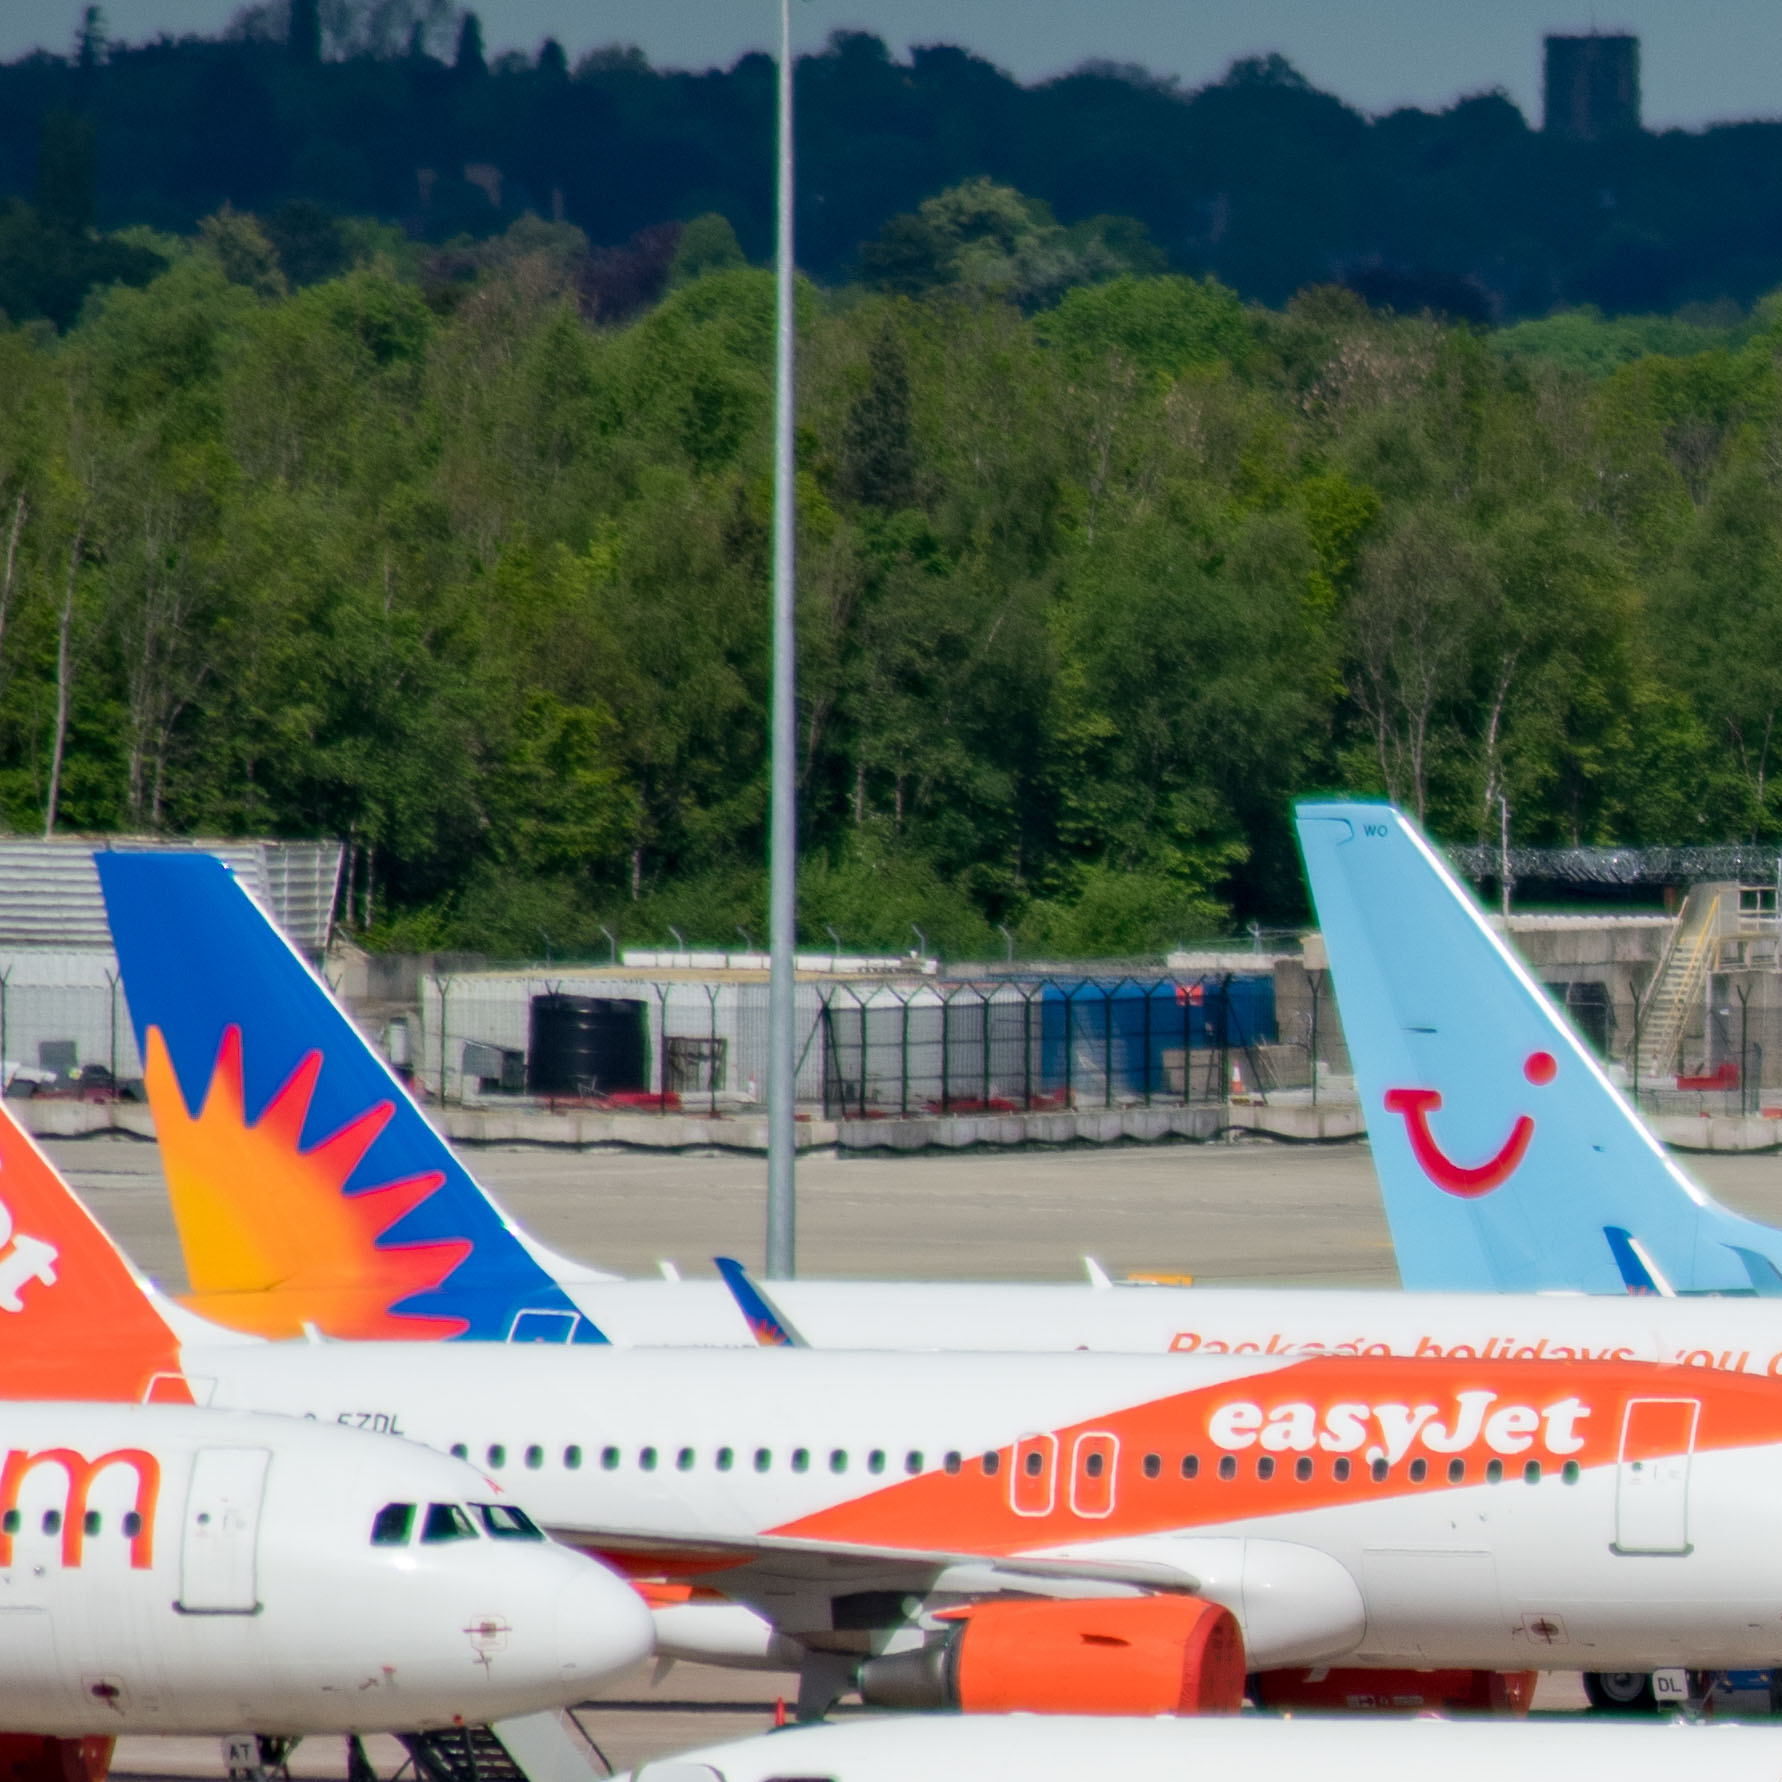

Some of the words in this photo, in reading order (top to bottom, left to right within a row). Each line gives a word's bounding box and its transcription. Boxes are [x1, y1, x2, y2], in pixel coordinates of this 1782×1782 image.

[1362, 823, 1388, 838] WO
[1208, 1390, 1592, 1466] easyJet
[1657, 1676, 1683, 1692] DL
[230, 1742, 250, 1762] AT
